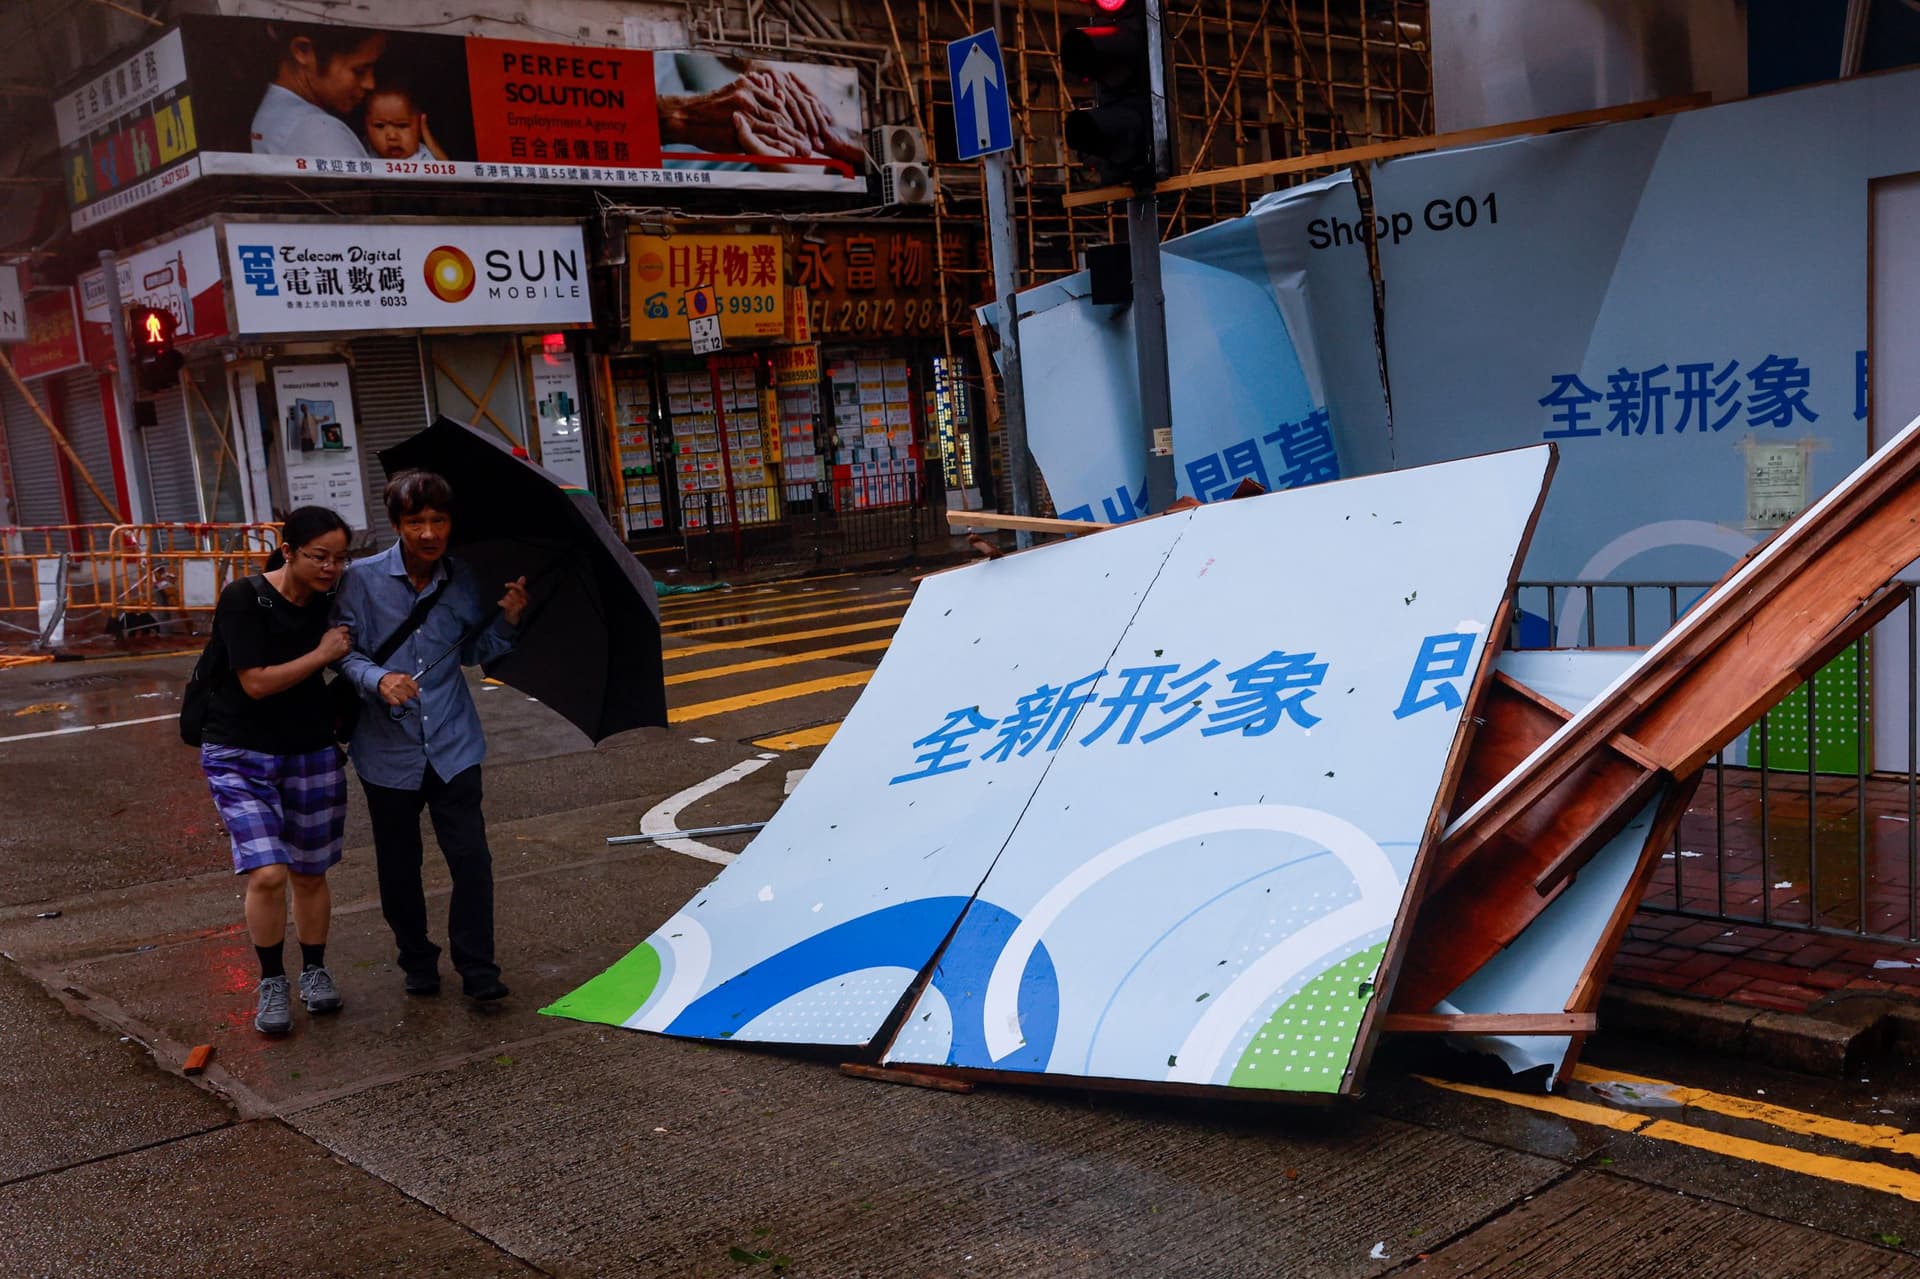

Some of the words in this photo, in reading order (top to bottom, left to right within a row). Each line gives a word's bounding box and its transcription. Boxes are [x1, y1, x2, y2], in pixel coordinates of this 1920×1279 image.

[502, 51, 623, 80] PERFECT
[504, 82, 625, 109] SOLUTION
[506, 111, 582, 131] Employment
[585, 115, 627, 134] Agency
[316, 158, 373, 174] 歡迎查詢
[386, 162, 418, 174] 3427
[424, 163, 456, 175] 5018
[1423, 192, 1498, 231] G01
[279, 246, 344, 264] Telecom
[348, 246, 402, 265] Digital
[486, 248, 579, 282] SUN
[669, 244, 777, 289] 日昇物業
[797, 232, 964, 292] 永富物業
[283, 266, 406, 296] 電訊數碼
[489, 285, 581, 300] MOBILE
[380, 296, 408, 307] 6033
[677, 296, 725, 316] 25
[729, 294, 775, 314] 9930
[706, 318, 713, 331] 7
[710, 336, 721, 350] 12
[1539, 353, 1819, 440] 全新形象
[889, 649, 1329, 785] 全新形象
